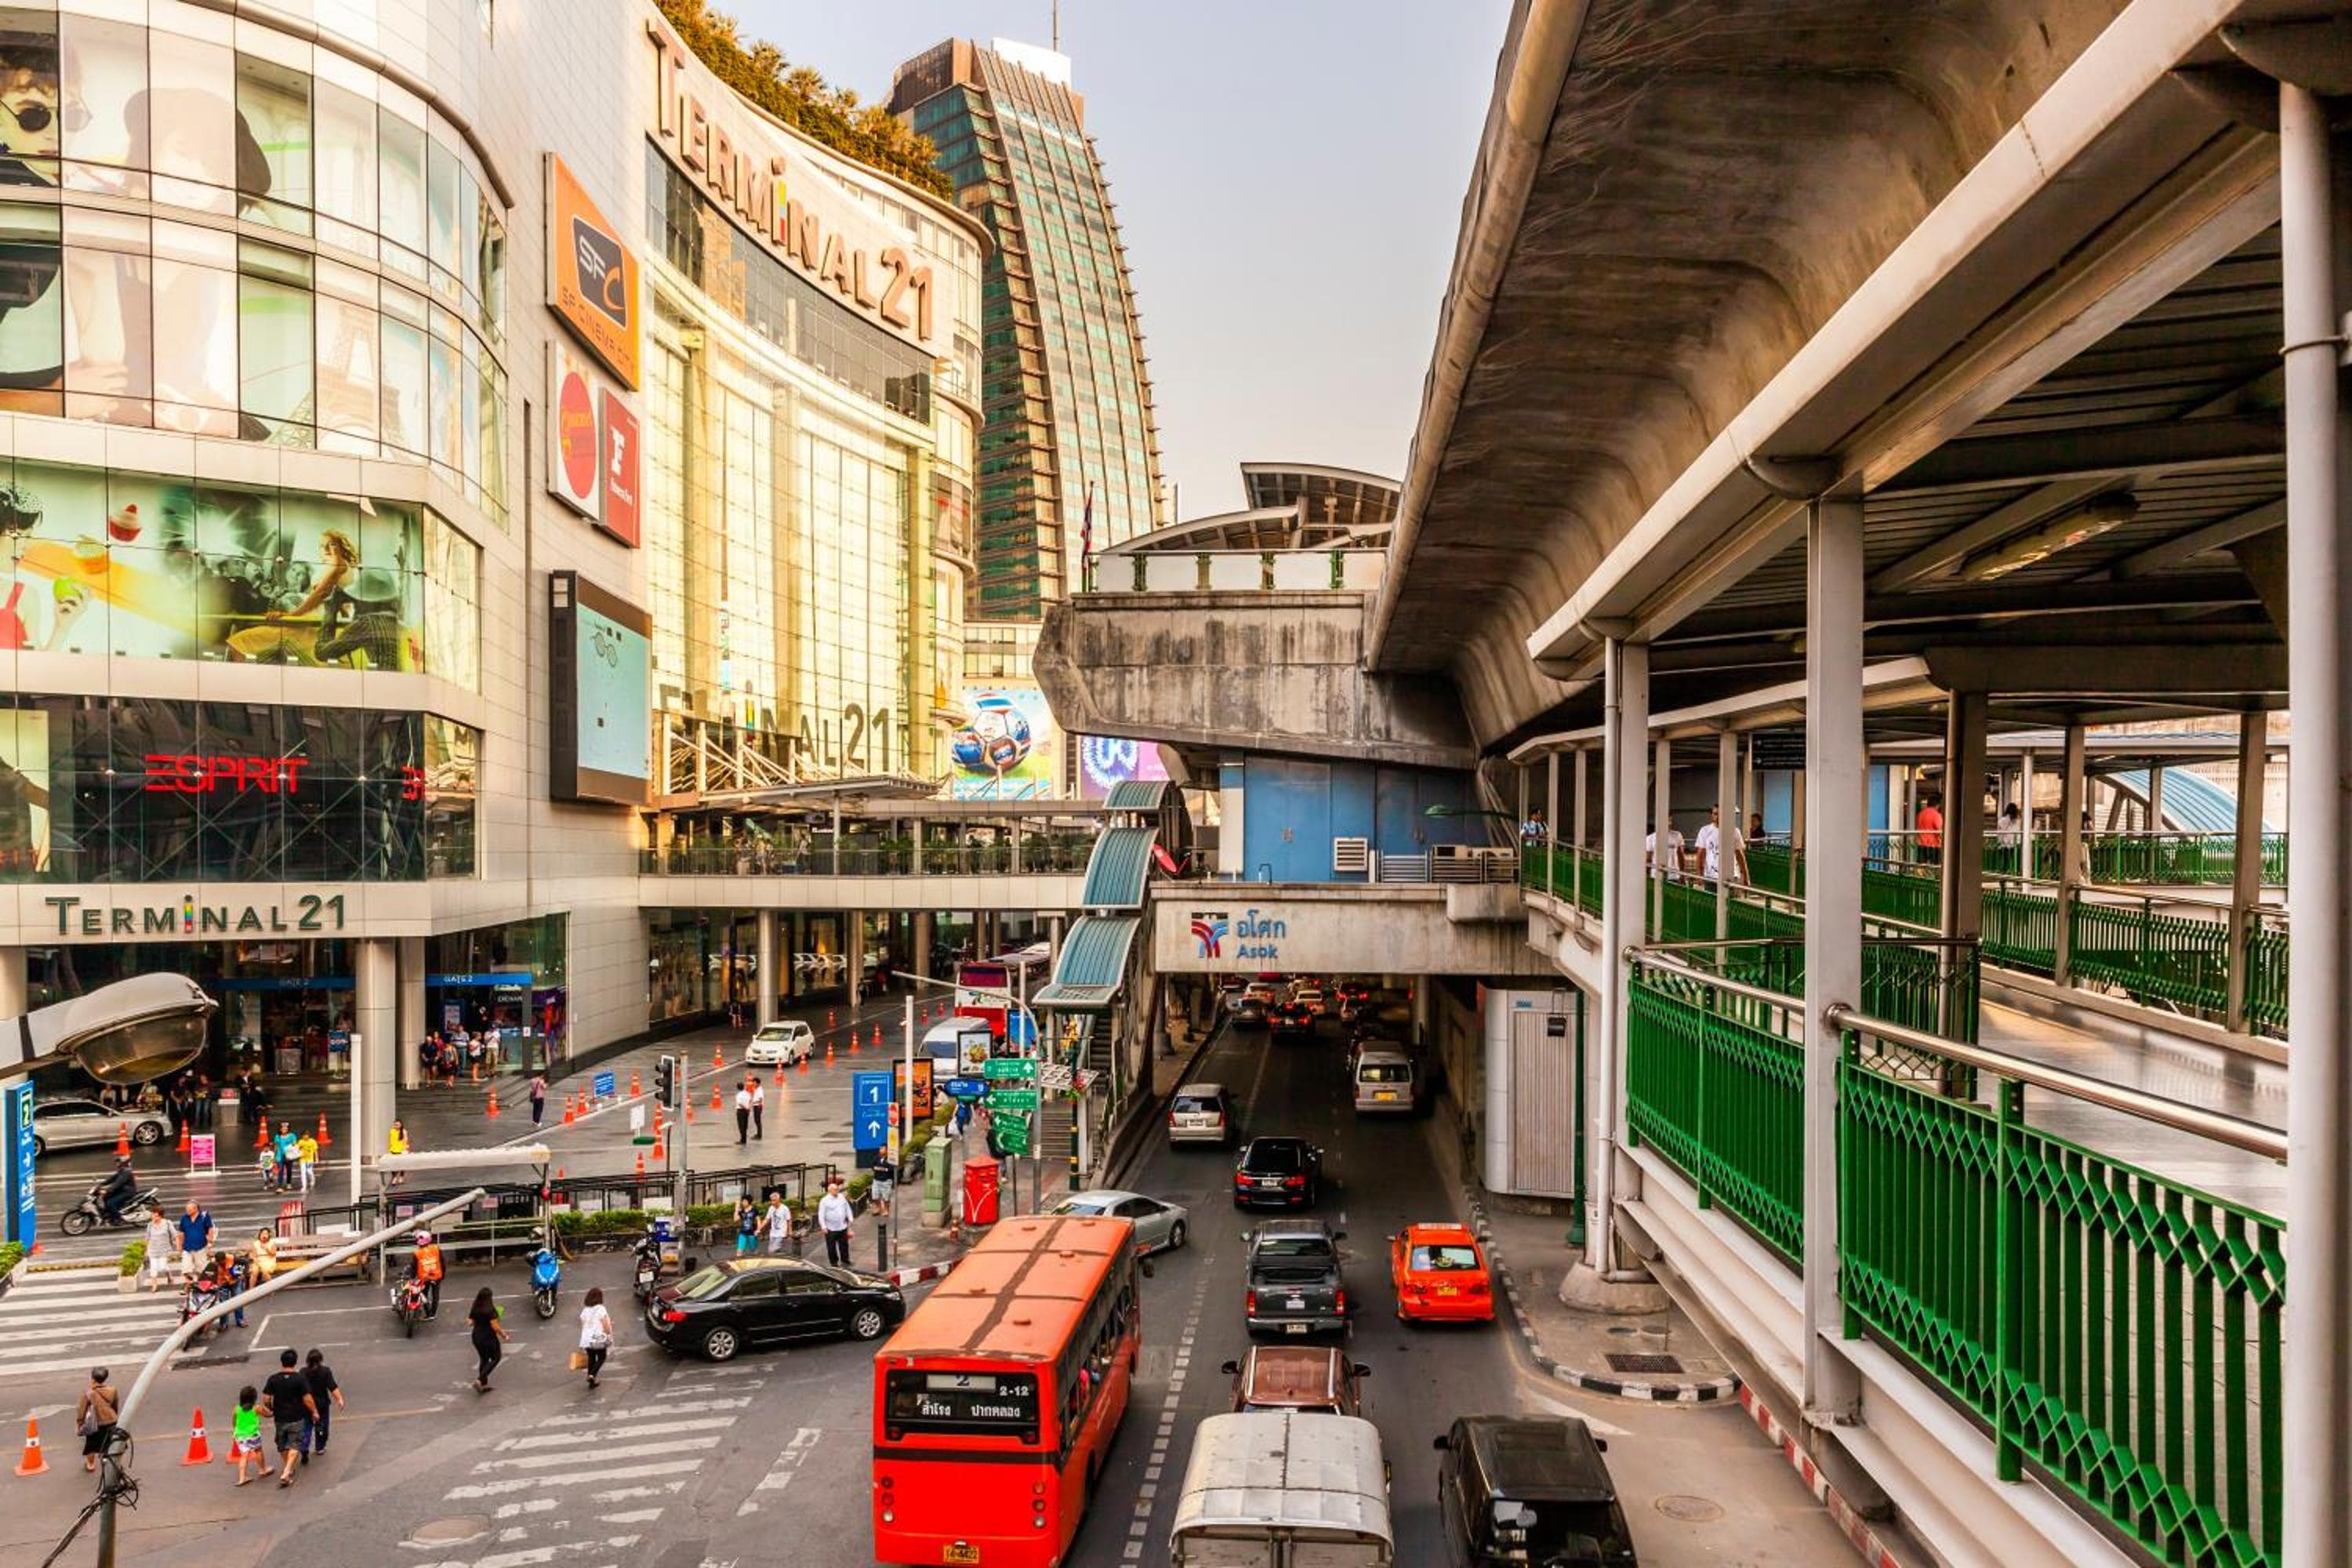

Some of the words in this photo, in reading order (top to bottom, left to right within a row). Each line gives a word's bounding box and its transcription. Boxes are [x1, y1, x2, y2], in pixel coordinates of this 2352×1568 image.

[579, 234, 626, 310] SFC
[880, 246, 935, 343] 21
[144, 753, 310, 795] ESPRIT
[298, 894, 345, 931] 21
[1236, 909, 1287, 939] อโศก
[1236, 943, 1279, 960] Asok
[444, 975, 466, 983] GATE
[869, 1086, 879, 1104] 1
[999, 1385, 1030, 1396] 2-12
[971, 1403, 1021, 1417] ปากคลอง
